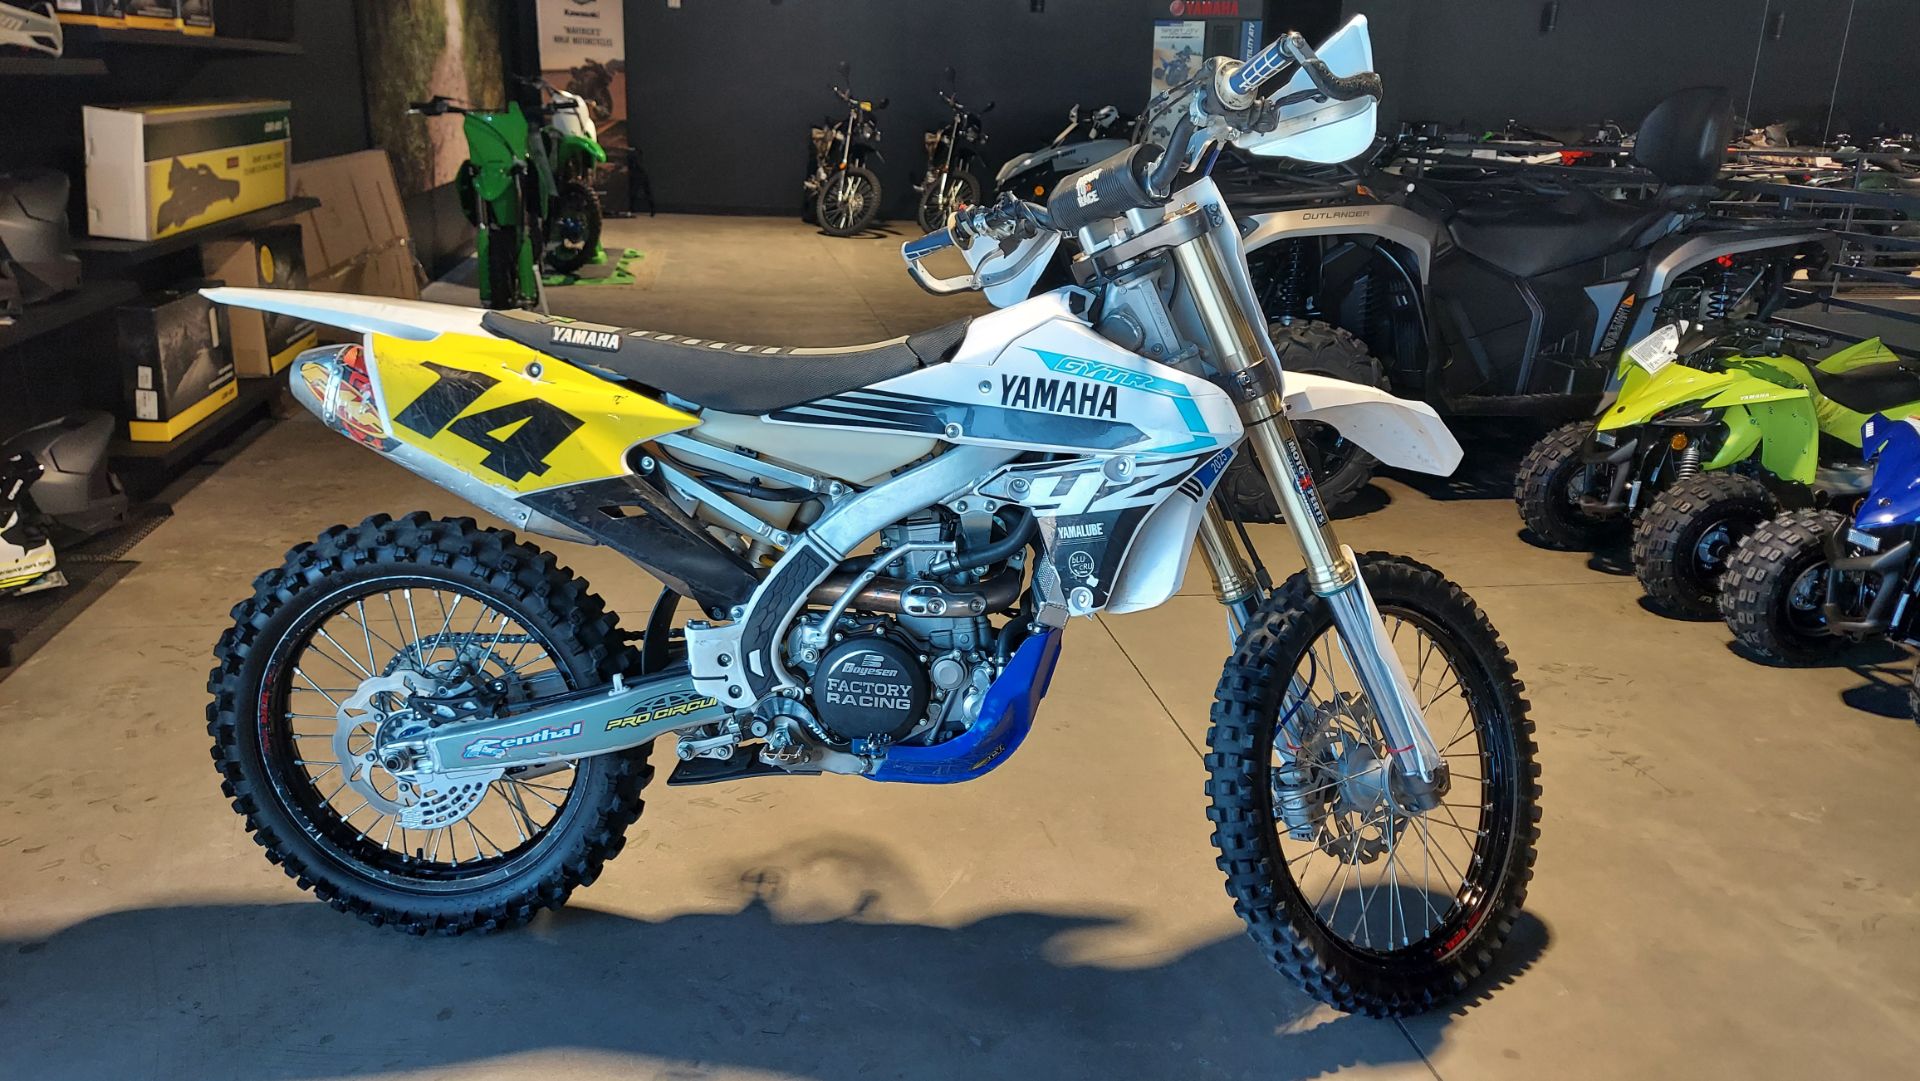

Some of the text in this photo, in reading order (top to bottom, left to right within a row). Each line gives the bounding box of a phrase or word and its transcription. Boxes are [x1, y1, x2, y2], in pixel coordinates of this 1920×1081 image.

[1185, 0, 1239, 16] YAMAHA
[1302, 210, 1370, 221] OUTLANDER
[553, 326, 619, 350] YAMAHA
[1055, 356, 1153, 389] GYTR
[1001, 374, 1118, 419] YAMAHA
[393, 361, 586, 482] 14
[1211, 453, 1228, 474] 2025
[1287, 440, 1306, 475] MOTO
[1057, 522, 1104, 539] YAMALUBE
[842, 662, 898, 677] Boyesen
[827, 678, 912, 697] FACTORY
[826, 692, 911, 710] RACING
[606, 697, 717, 731] PRO CIRCUI
[463, 721, 582, 759] Renthal
